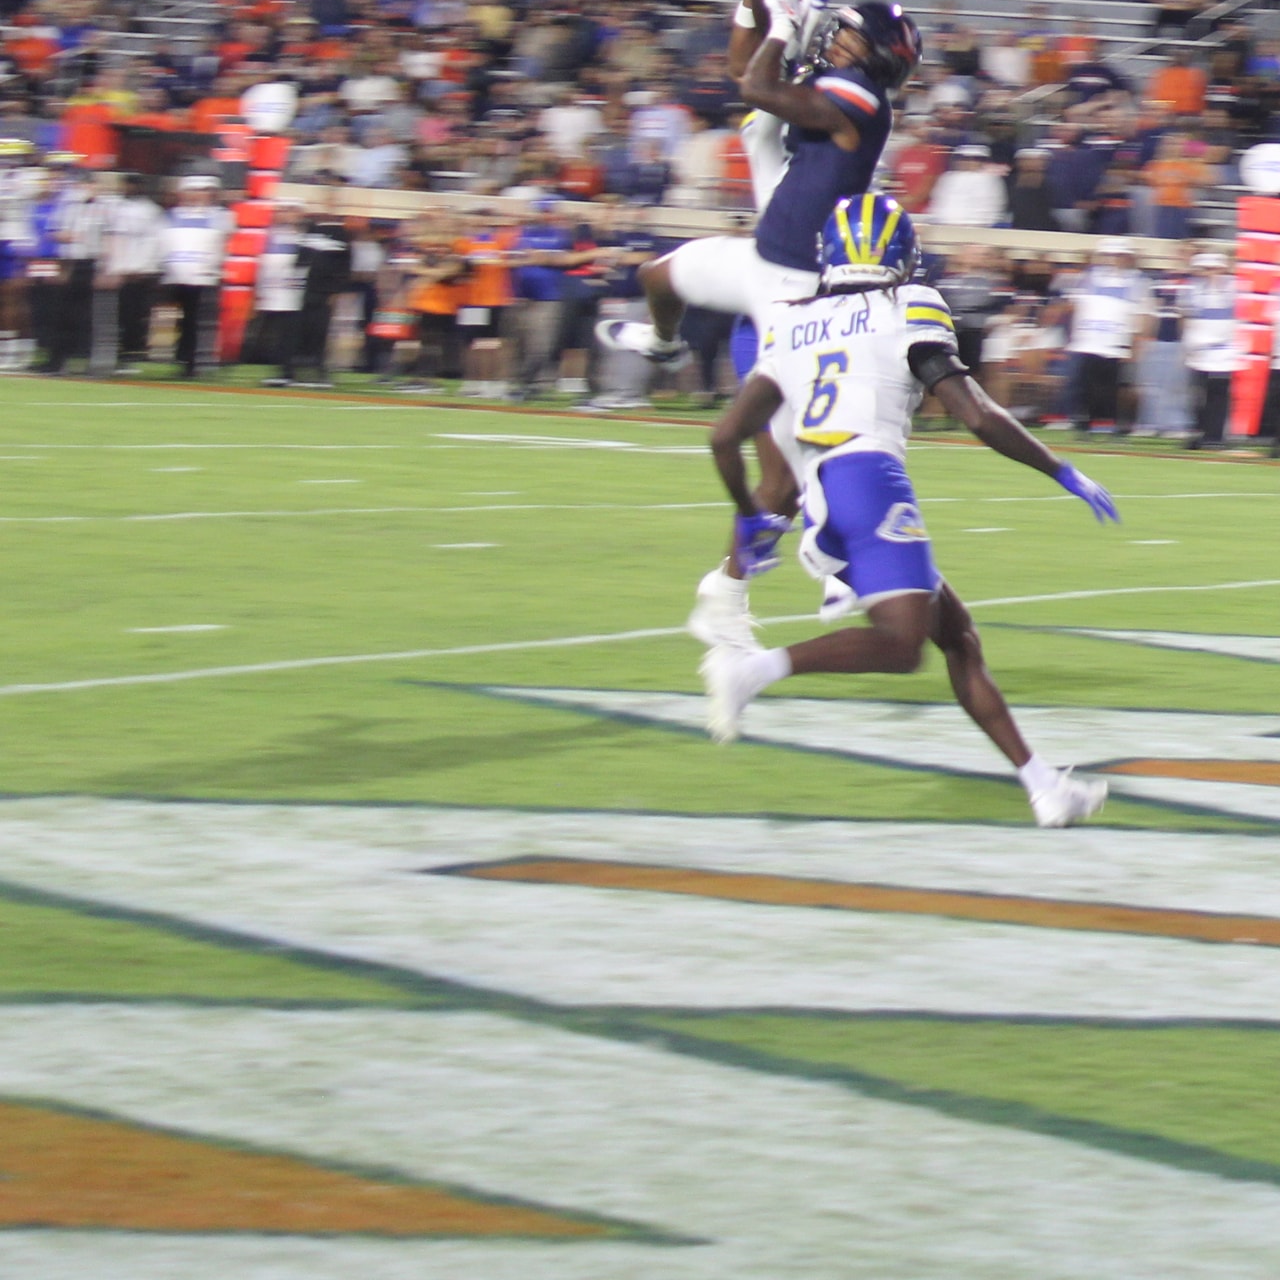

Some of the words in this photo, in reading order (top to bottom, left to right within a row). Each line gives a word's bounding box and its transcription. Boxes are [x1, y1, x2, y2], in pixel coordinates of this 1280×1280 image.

[791, 316, 834, 351] COX
[841, 309, 877, 337] JR.
[801, 349, 849, 430] 6
